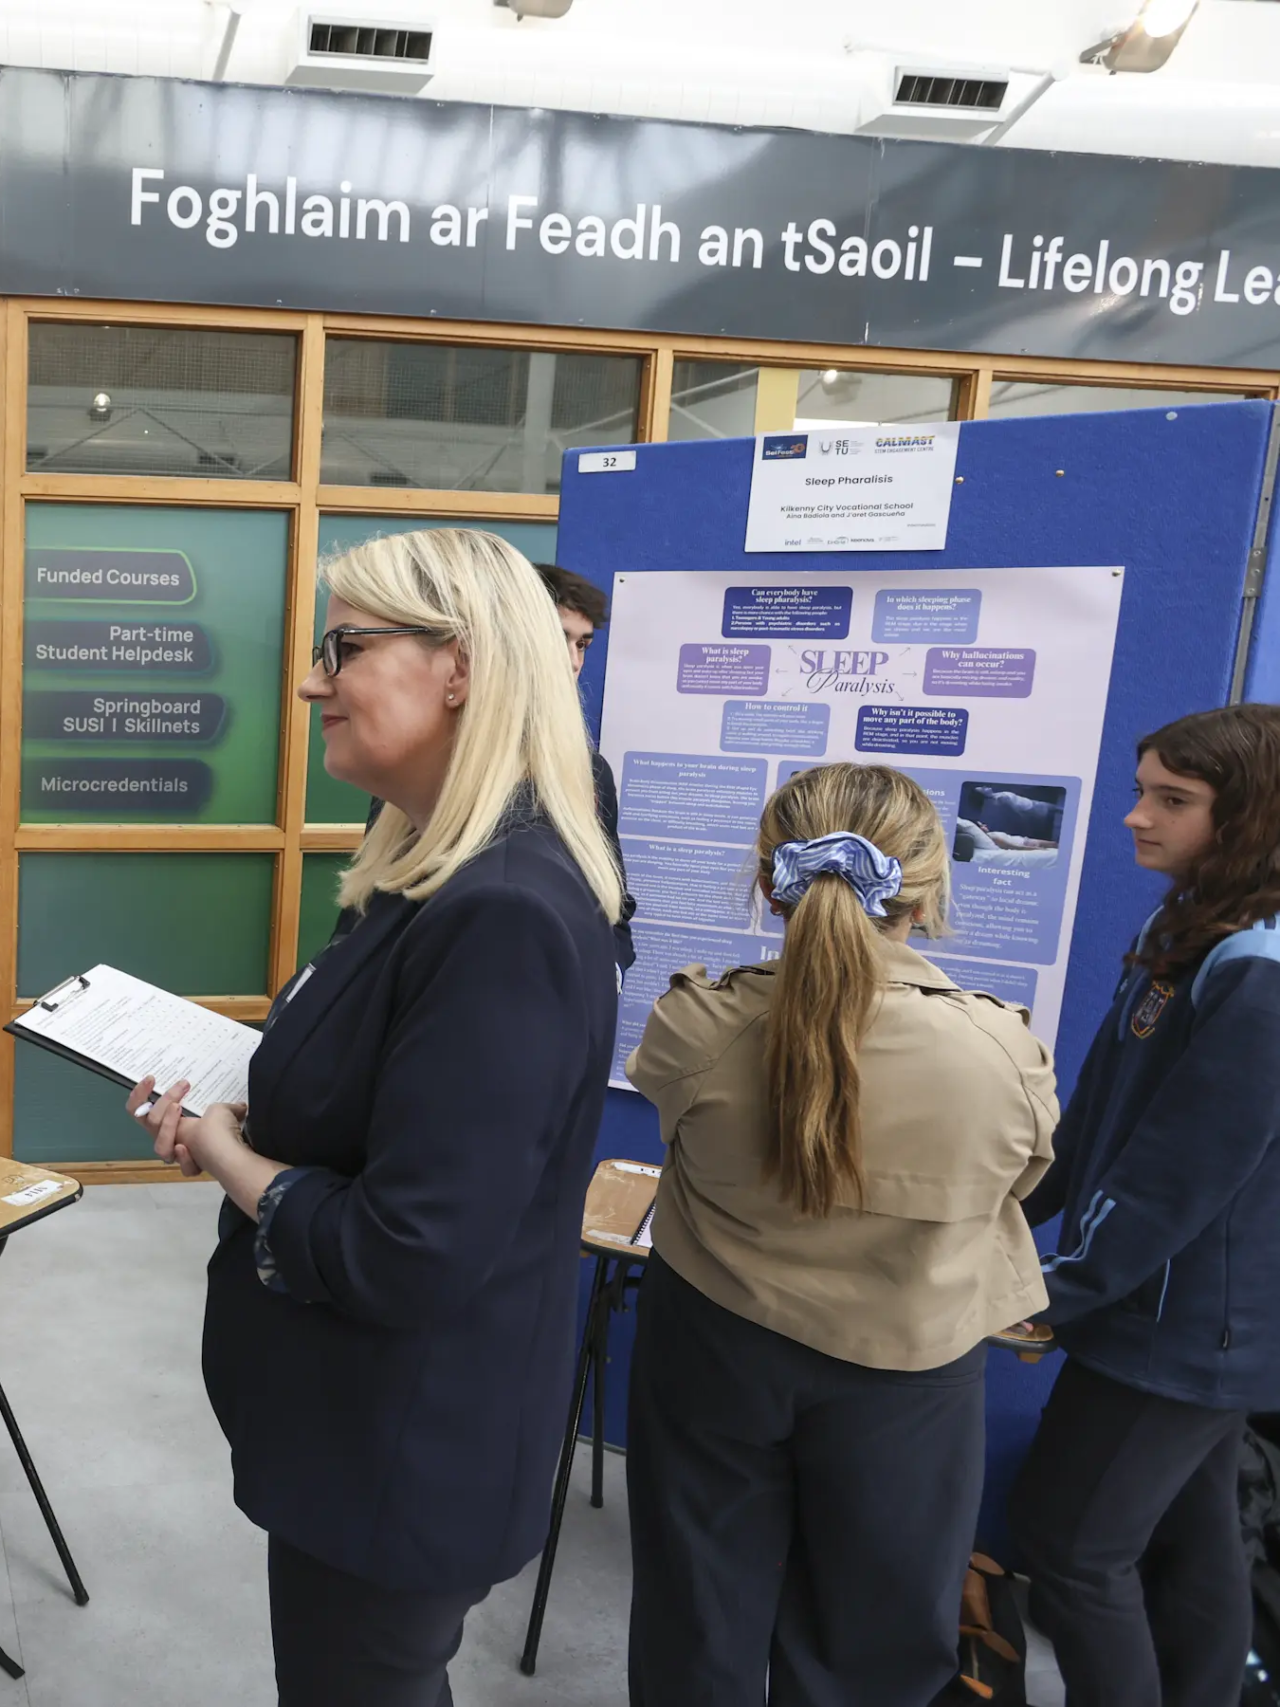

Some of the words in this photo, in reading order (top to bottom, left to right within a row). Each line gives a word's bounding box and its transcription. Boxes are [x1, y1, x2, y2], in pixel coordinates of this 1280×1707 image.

[131, 168, 410, 248] Foghlaim
[429, 203, 489, 247] ar
[506, 195, 681, 262] Feadh
[698, 223, 763, 268] an
[781, 218, 933, 281] tSaoil
[998, 234, 1204, 315] Lifelong
[1214, 250, 1280, 306] Le
[835, 439, 849, 447] SE
[875, 435, 935, 447] CALMAST
[835, 447, 849, 455] TU
[603, 457, 616, 467] 32
[805, 477, 835, 487] Sleep
[838, 474, 893, 485] Pharalisis
[836, 503, 882, 511] Vocational
[37, 567, 102, 584] Funded
[106, 569, 180, 586] Courses
[766, 589, 800, 598] everybody
[756, 596, 772, 604] sleep
[918, 596, 948, 604] sleeping
[950, 596, 971, 604] phase
[922, 604, 957, 612] happens?
[110, 626, 194, 642] Part-time
[36, 645, 108, 660] Student
[112, 646, 193, 665] Helpdesk
[730, 648, 749, 656] sleep
[942, 651, 960, 660] Why
[962, 651, 1024, 659] hallucinations
[706, 655, 742, 664] paralysis?
[800, 649, 889, 675] SLEEP
[976, 660, 1004, 668] occur?
[807, 668, 895, 696] Paralysis
[93, 698, 201, 717] Springboard
[802, 704, 808, 712] it
[872, 708, 888, 717] Why
[915, 709, 946, 718] possible
[63, 717, 104, 732] SUSI
[124, 718, 200, 733] Skillnets
[884, 717, 897, 725] any
[940, 719, 963, 727] body?
[41, 777, 188, 792] Microcredentials
[694, 849, 725, 857] paralysis?
[978, 867, 1030, 878] Interesting
[993, 878, 1012, 886] fact
